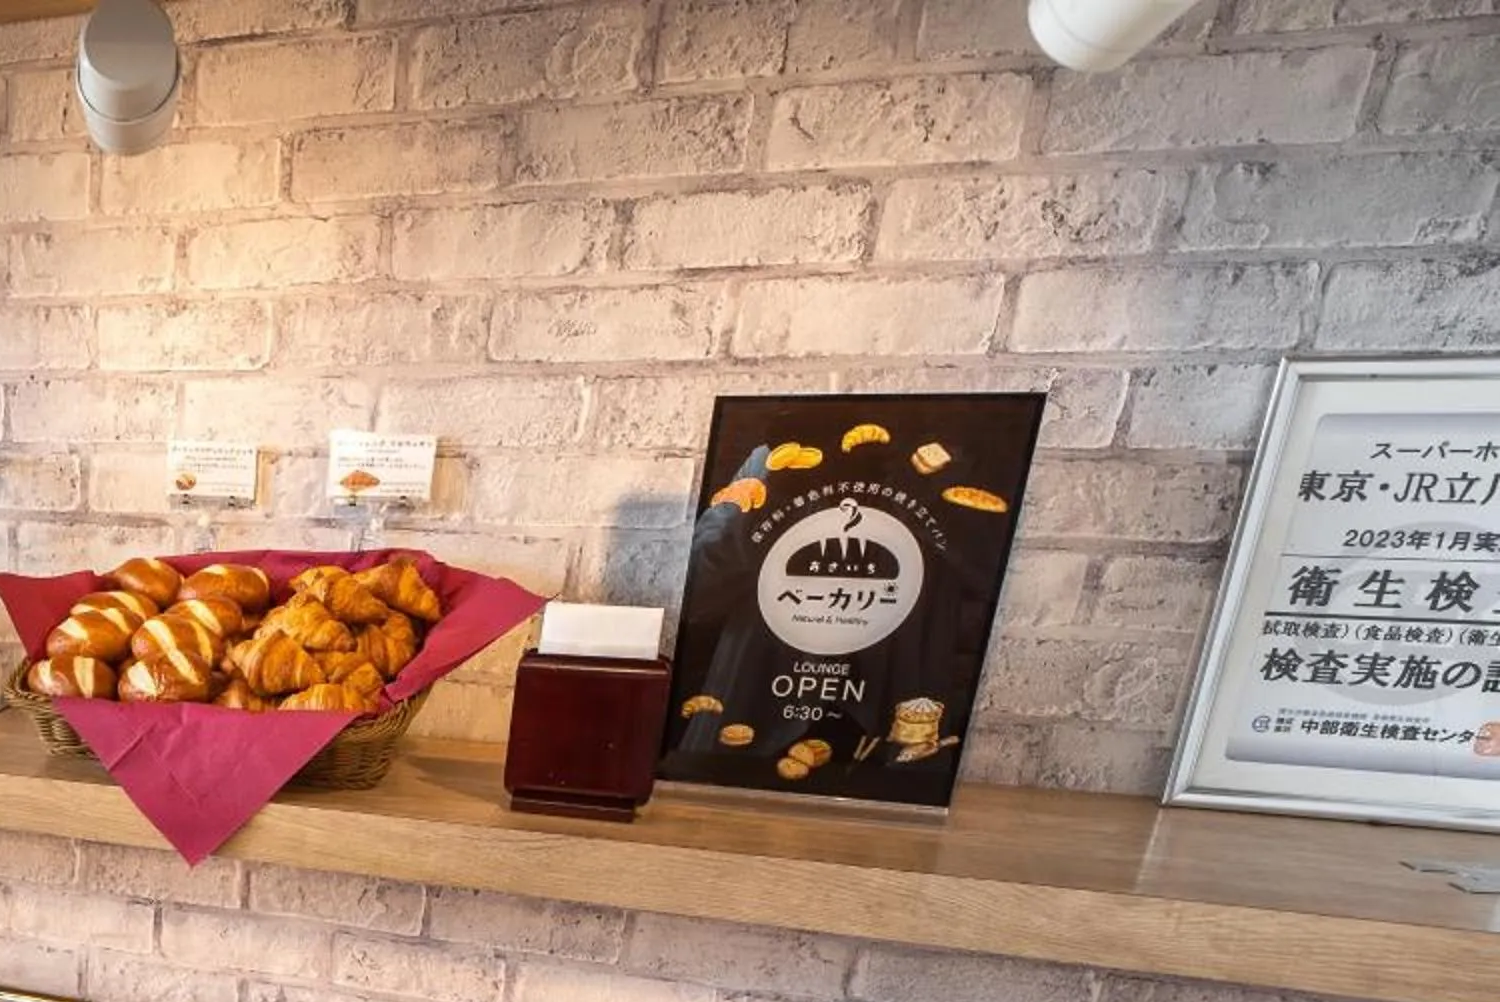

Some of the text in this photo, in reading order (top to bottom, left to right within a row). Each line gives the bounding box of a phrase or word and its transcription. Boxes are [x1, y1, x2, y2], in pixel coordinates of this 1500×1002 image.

[1342, 529, 1500, 553] 2023年1月実
[777, 586, 898, 612] ベーカリー
[1288, 565, 1500, 613] 衛生検
[793, 661, 851, 676] LOUNGE
[771, 675, 866, 703] OPEN
